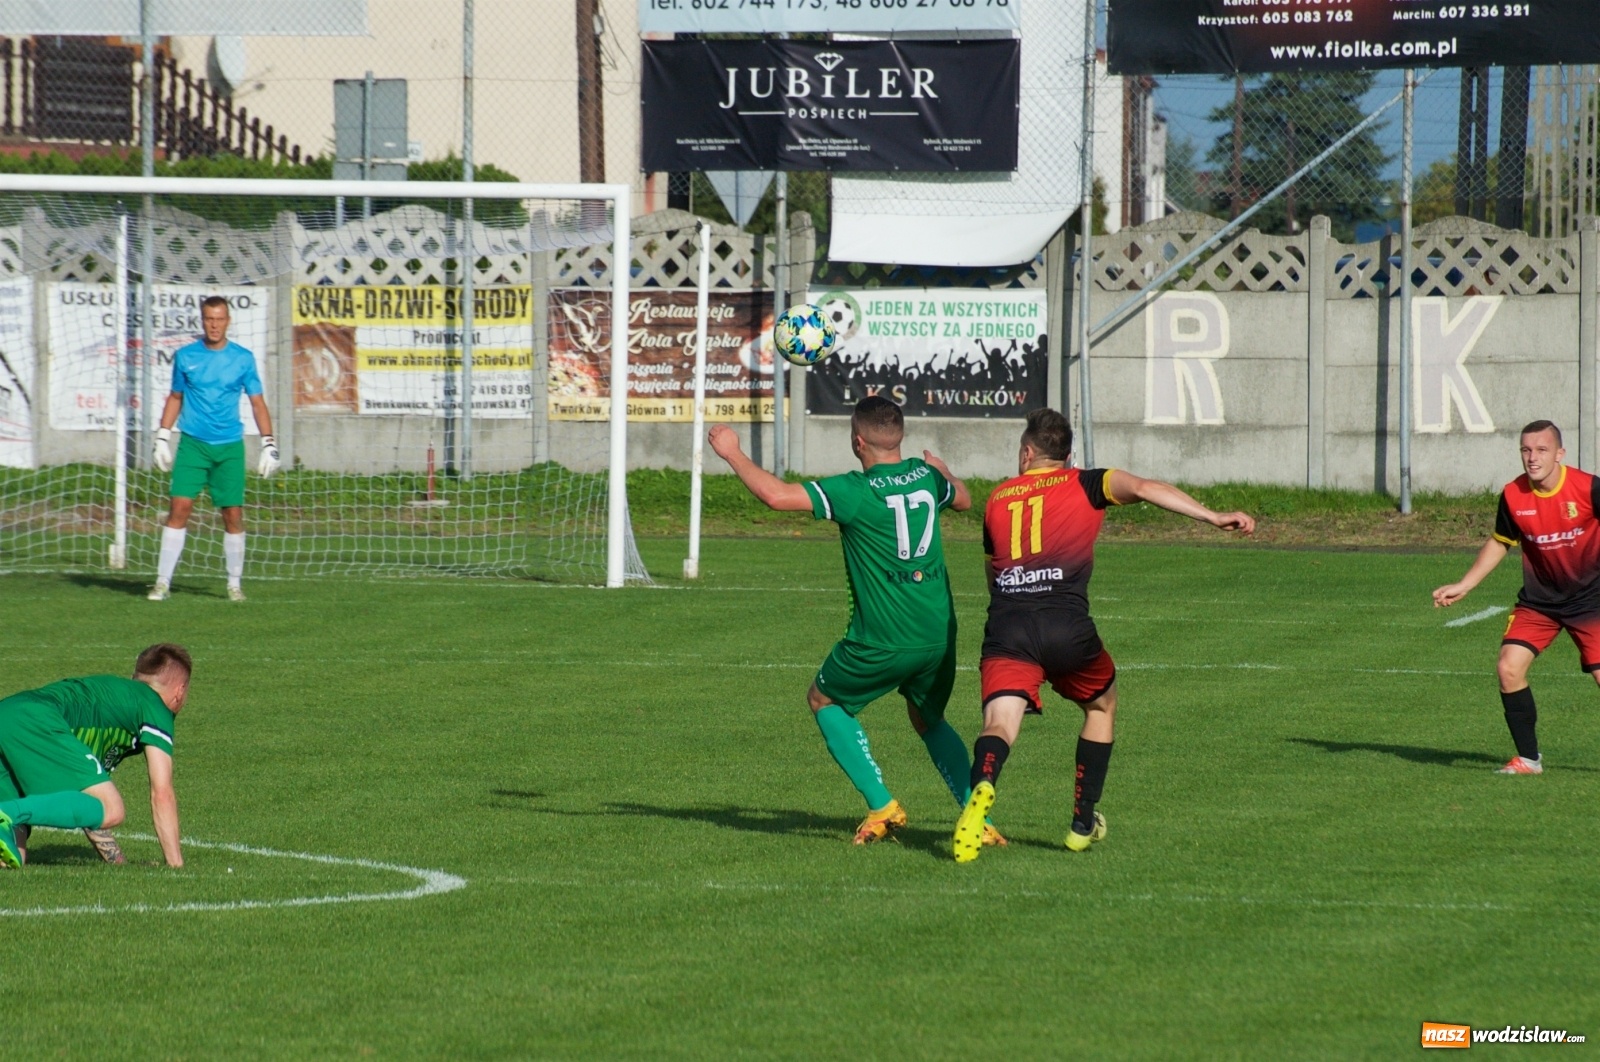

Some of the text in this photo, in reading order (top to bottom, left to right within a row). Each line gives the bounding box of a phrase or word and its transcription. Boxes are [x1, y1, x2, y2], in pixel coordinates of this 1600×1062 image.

[1197, 10, 1353, 27] Krzysztof: 605 083 762
[1392, 4, 1530, 20] Marcin: 607 336 321
[1270, 37, 1457, 59] www.fiolka.com.pl
[787, 107, 868, 119] POŚPIECH
[60, 290, 136, 306] USŁUI
[628, 297, 735, 324] Restaurcja
[865, 300, 1039, 318] JEDEN ZA WSZYSTKICH
[413, 330, 481, 345] Product
[868, 320, 1036, 339] WSZYSCY ZA JEDNEGO
[692, 363, 742, 377] ctering
[1144, 290, 1504, 433] R K
[683, 376, 775, 393] oklicznościow
[76, 393, 108, 409] tel.
[923, 385, 1028, 407] TWORKÓW
[626, 403, 667, 416] Główna
[671, 404, 684, 416] 11
[715, 404, 735, 416] 798
[738, 404, 758, 415] 441
[763, 403, 777, 415] 25
[885, 489, 936, 560] 17
[1007, 494, 1045, 561] 11
